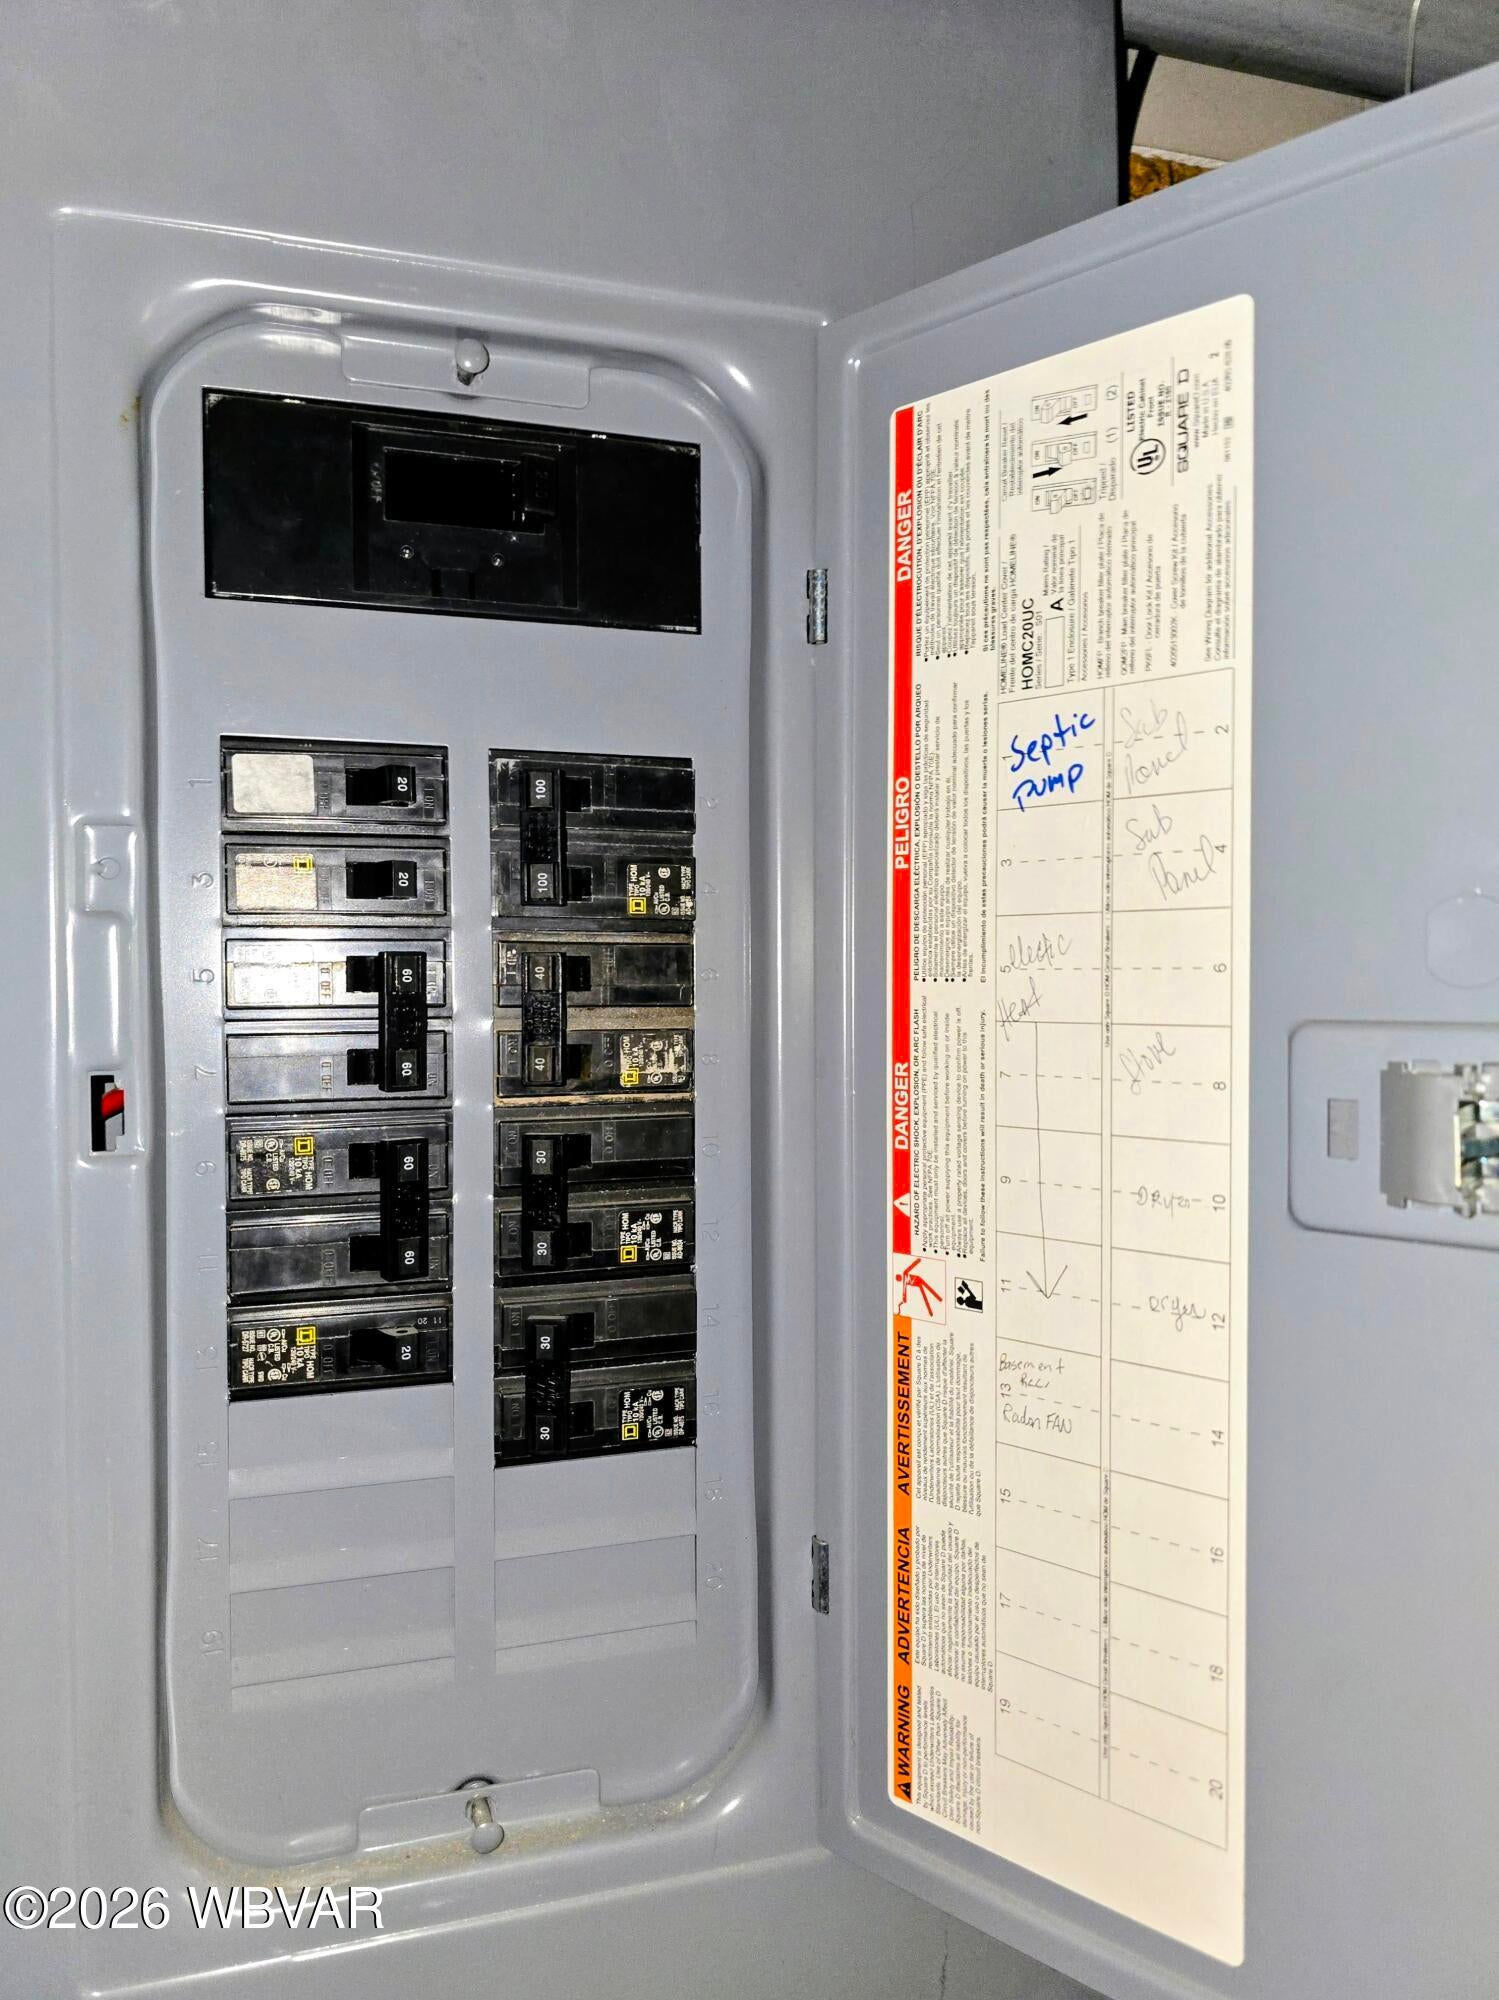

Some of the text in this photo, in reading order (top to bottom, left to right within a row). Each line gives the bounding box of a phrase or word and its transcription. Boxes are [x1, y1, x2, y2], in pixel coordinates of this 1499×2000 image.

[1106, 385, 1119, 400] (2)
[1127, 391, 1135, 432] LISTED
[1177, 369, 1189, 473] SQUARE D
[1106, 427, 1119, 443] (1)
[897, 489, 912, 582] DANGER
[1050, 598, 1064, 611] A
[1022, 598, 1034, 689] HOMC20UC
[1068, 664, 1076, 683] Type
[1216, 725, 1229, 734] 2
[1011, 713, 1096, 772] Septic
[397, 777, 408, 792] 20
[536, 779, 546, 799] 100
[895, 776, 910, 869] PELIGRO
[1125, 804, 1172, 850] Sub
[1215, 844, 1227, 853] 4
[1001, 859, 1012, 867] 3
[191, 873, 214, 888] 3
[398, 872, 408, 887] 20
[538, 872, 548, 892] 100
[640, 887, 645, 896] 10
[914, 934, 920, 944] DE
[535, 966, 545, 980] 40
[1000, 965, 1011, 973] 5
[1213, 963, 1227, 973] 6
[193, 969, 215, 984] 5
[402, 969, 413, 983] 60
[535, 1058, 545, 1071] 40
[633, 1058, 638, 1067] 10
[914, 1056, 919, 1067] OR
[194, 1065, 216, 1078] 7
[402, 1062, 412, 1077] 60
[1213, 1081, 1226, 1090] 8
[895, 1062, 909, 1150] DANGER
[295, 1157, 301, 1166] 10
[404, 1156, 414, 1170] 60
[536, 1151, 546, 1164] 30
[305, 1172, 313, 1190] HOM
[1001, 1176, 1011, 1184] 9
[914, 1190, 919, 1200] OF
[1213, 1194, 1226, 1211] 10
[631, 1235, 637, 1244] 10
[537, 1242, 547, 1256] 30
[405, 1251, 415, 1265] 60
[1001, 1279, 1011, 1292] 11
[1212, 1313, 1225, 1330] 12
[541, 1336, 550, 1350] 30
[296, 1346, 303, 1356] 10
[401, 1346, 411, 1361] 20
[306, 1361, 314, 1379] HOM
[1000, 1383, 1011, 1397] 13
[633, 1413, 639, 1422] 10
[898, 1331, 910, 1495] AVERTISSEMENT
[1046, 1413, 1072, 1433] FAN
[540, 1427, 550, 1440] 30
[1211, 1430, 1224, 1447] 14
[1000, 1489, 1011, 1504] 15
[1210, 1548, 1223, 1564] 16
[898, 1527, 910, 1665] ADVERTENCIA
[1000, 1593, 1011, 1608] 17
[1210, 1665, 1223, 1682] 18
[1000, 1699, 1011, 1714] 19
[898, 1685, 910, 1776] WARNING
[1210, 1779, 1223, 1799] 20
